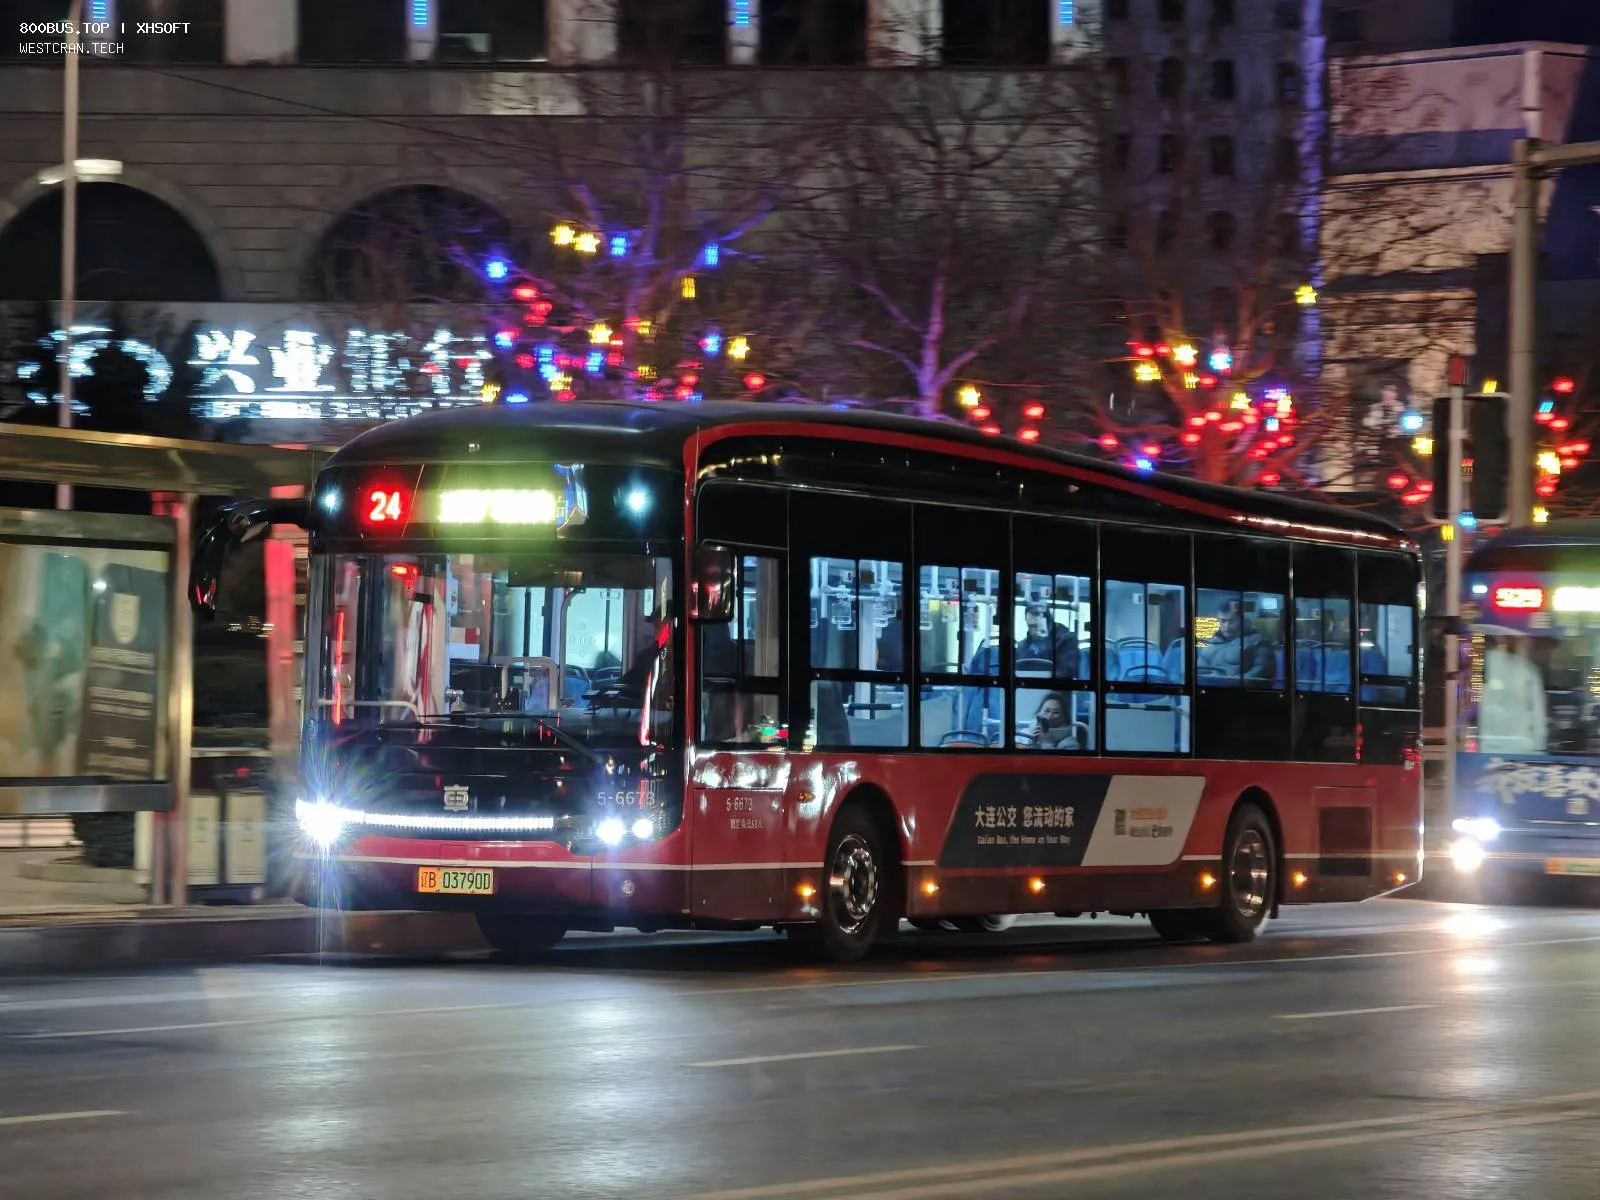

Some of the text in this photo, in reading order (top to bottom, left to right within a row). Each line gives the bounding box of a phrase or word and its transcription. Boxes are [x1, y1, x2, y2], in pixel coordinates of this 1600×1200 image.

[370, 490, 401, 521] 24
[975, 804, 1017, 828] 大连公交
